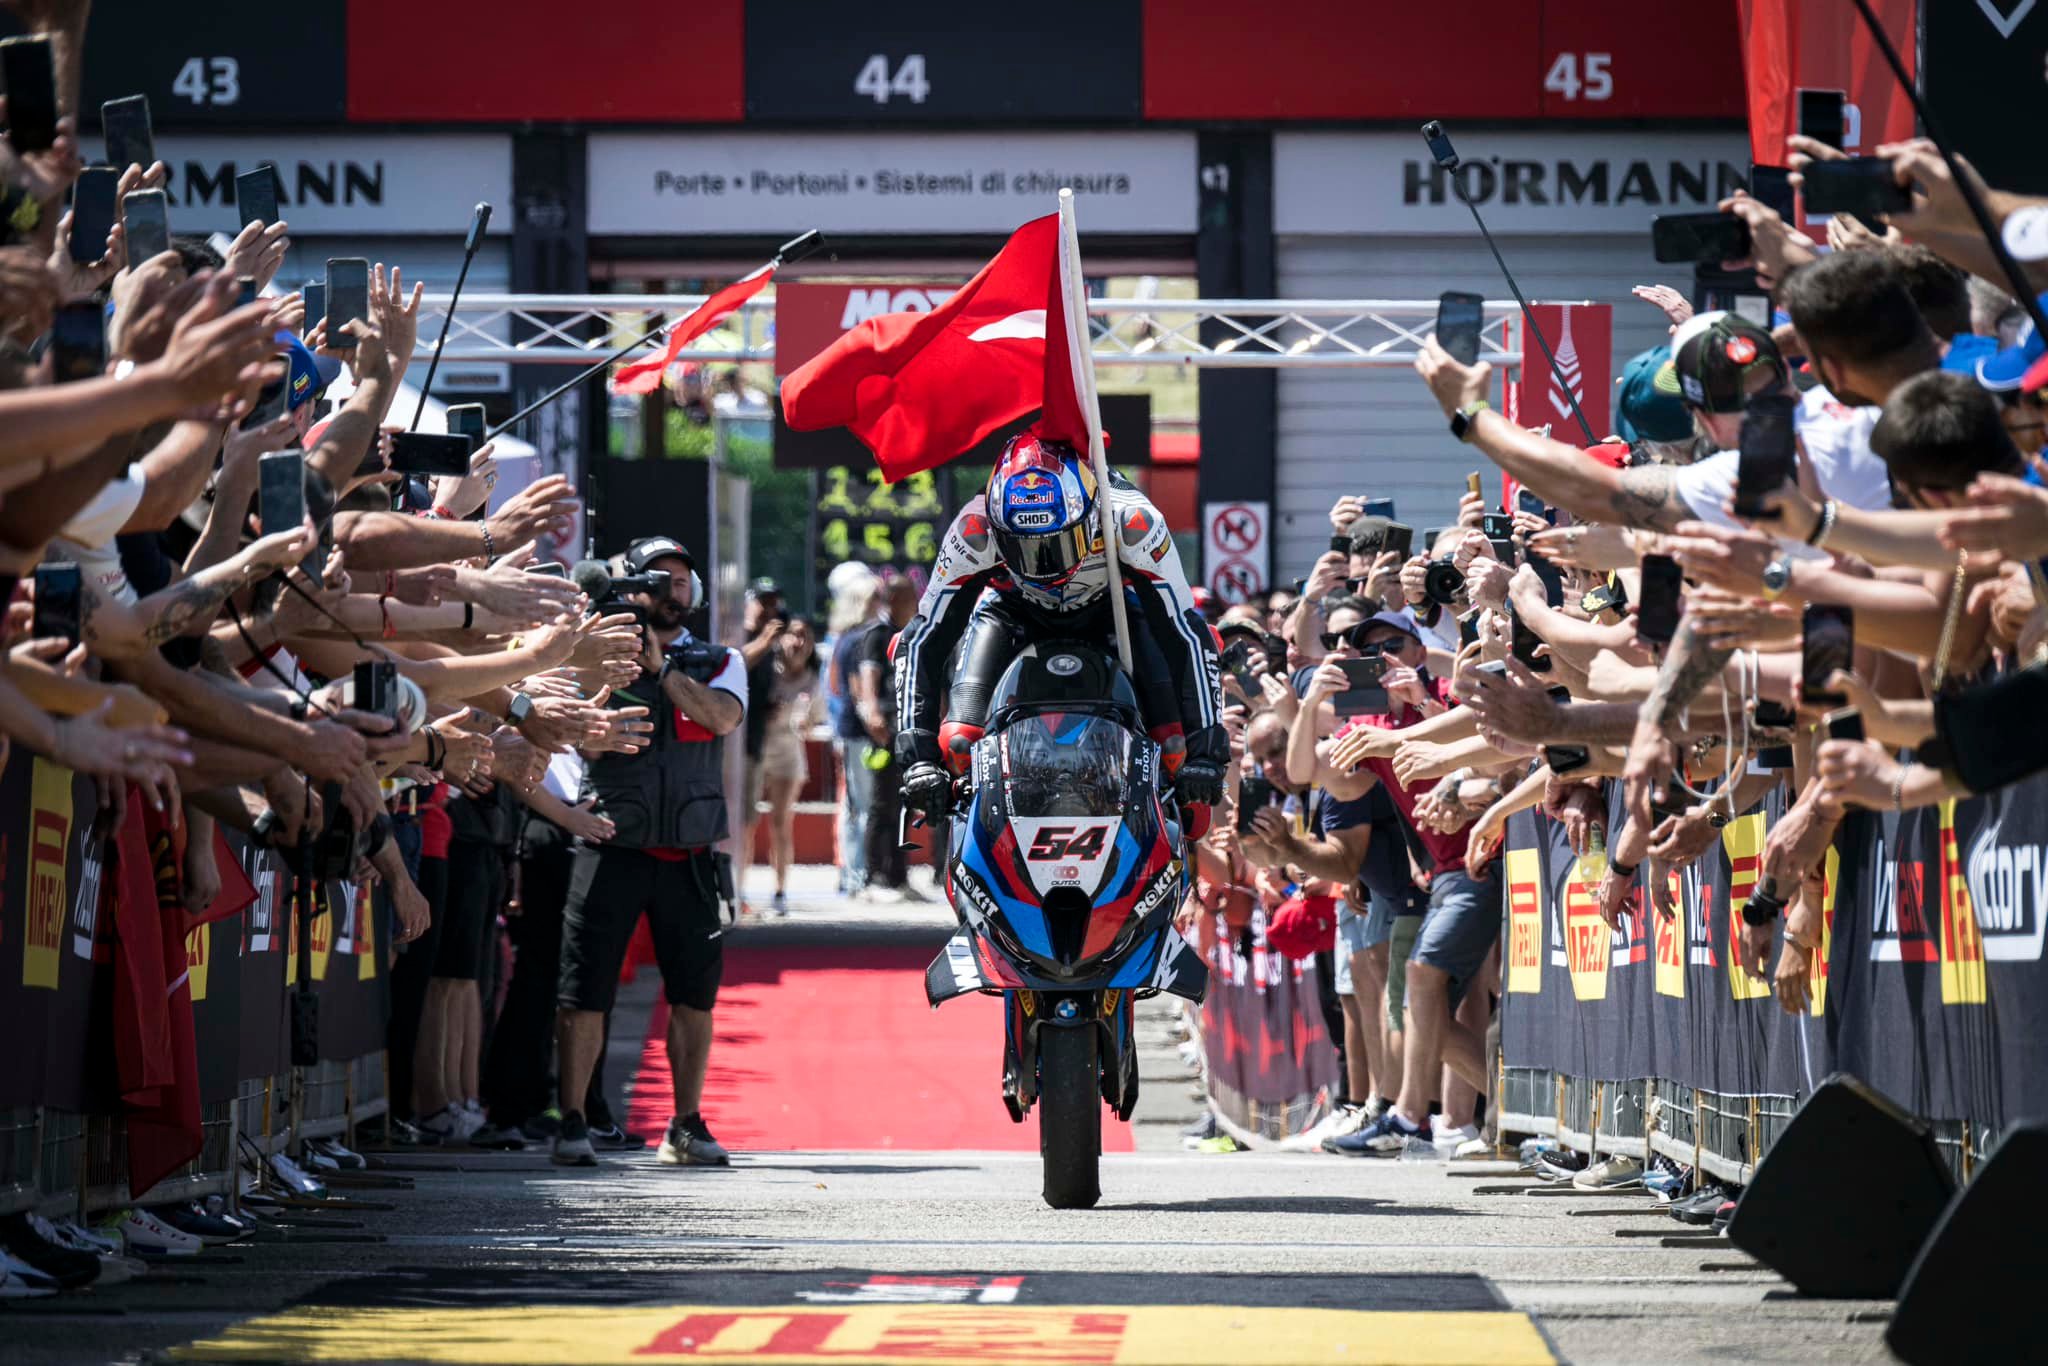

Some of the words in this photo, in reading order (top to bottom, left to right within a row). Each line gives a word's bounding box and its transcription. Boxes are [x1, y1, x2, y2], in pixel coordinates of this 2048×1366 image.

[172, 56, 240, 104] 43
[855, 53, 931, 103] 44
[1545, 53, 1614, 100] 45
[655, 170, 726, 195] Porte
[750, 170, 849, 195] Portoni
[873, 170, 973, 195] Sistemi
[980, 170, 1006, 195] di
[1013, 170, 1130, 195] chiusura
[1017, 513, 1049, 525] SHOEI
[904, 522, 937, 562] 6
[1142, 747, 1152, 783] EDOX
[1027, 825, 1109, 862] 54
[955, 861, 999, 917] ROKiT
[1133, 861, 1177, 919] ROKiT
